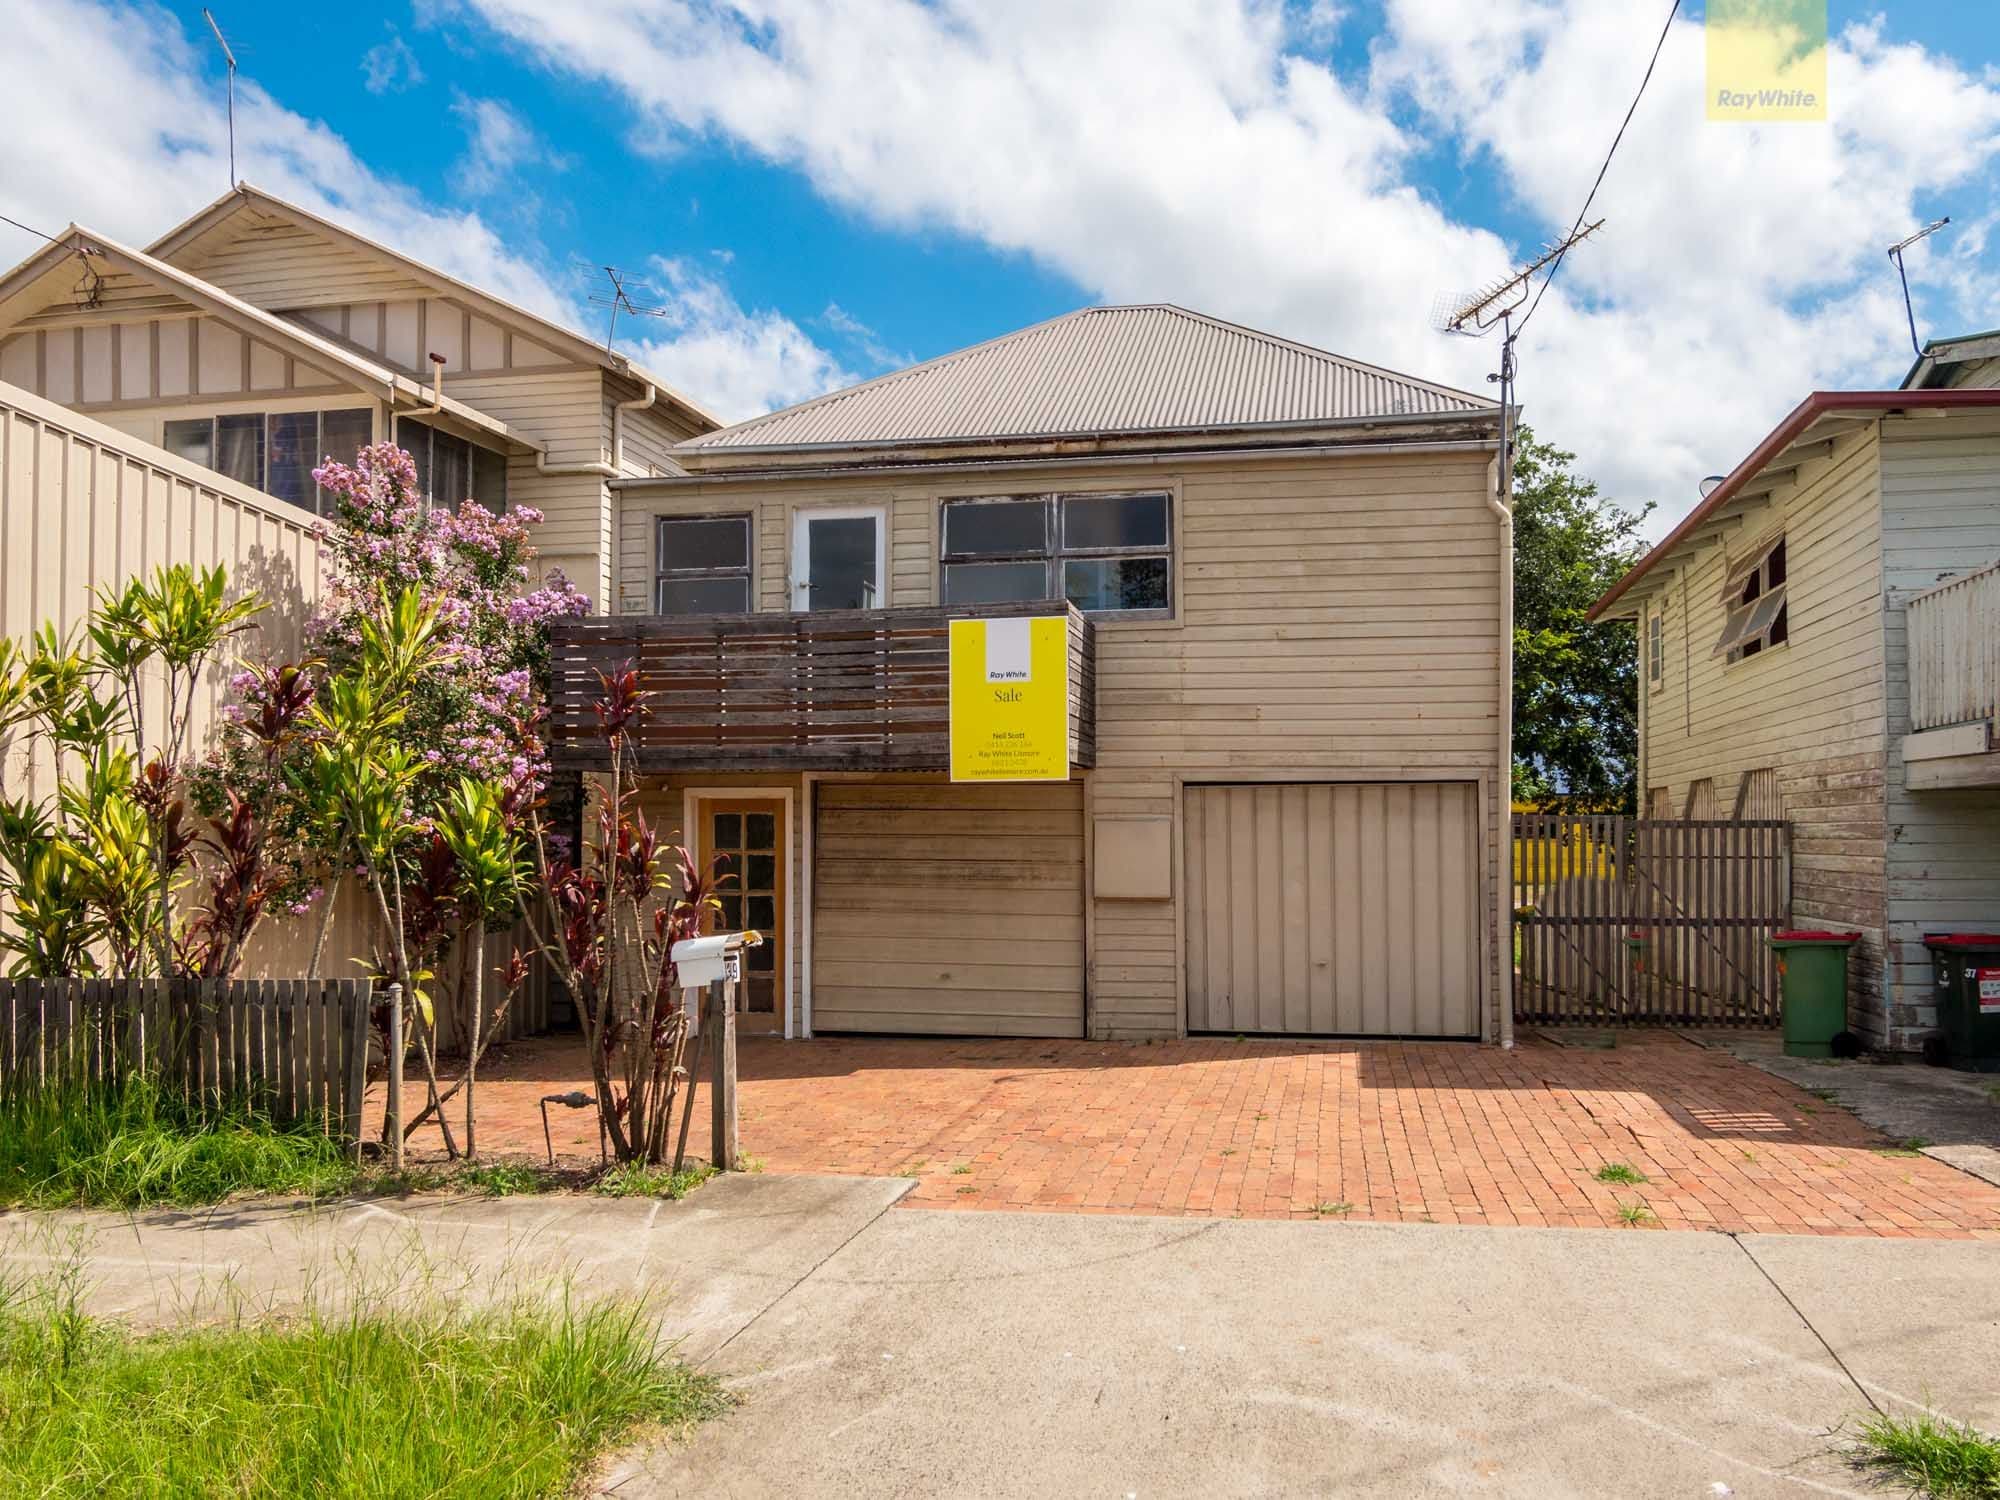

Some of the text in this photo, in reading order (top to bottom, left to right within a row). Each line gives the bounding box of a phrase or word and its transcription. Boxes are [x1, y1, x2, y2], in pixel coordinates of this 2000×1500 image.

[990, 670, 1028, 679] Ray White
[994, 687, 1023, 703] Sale
[992, 731, 1025, 740] Neil Scott
[992, 750, 1013, 758] White
[1964, 967, 1977, 979] 37
